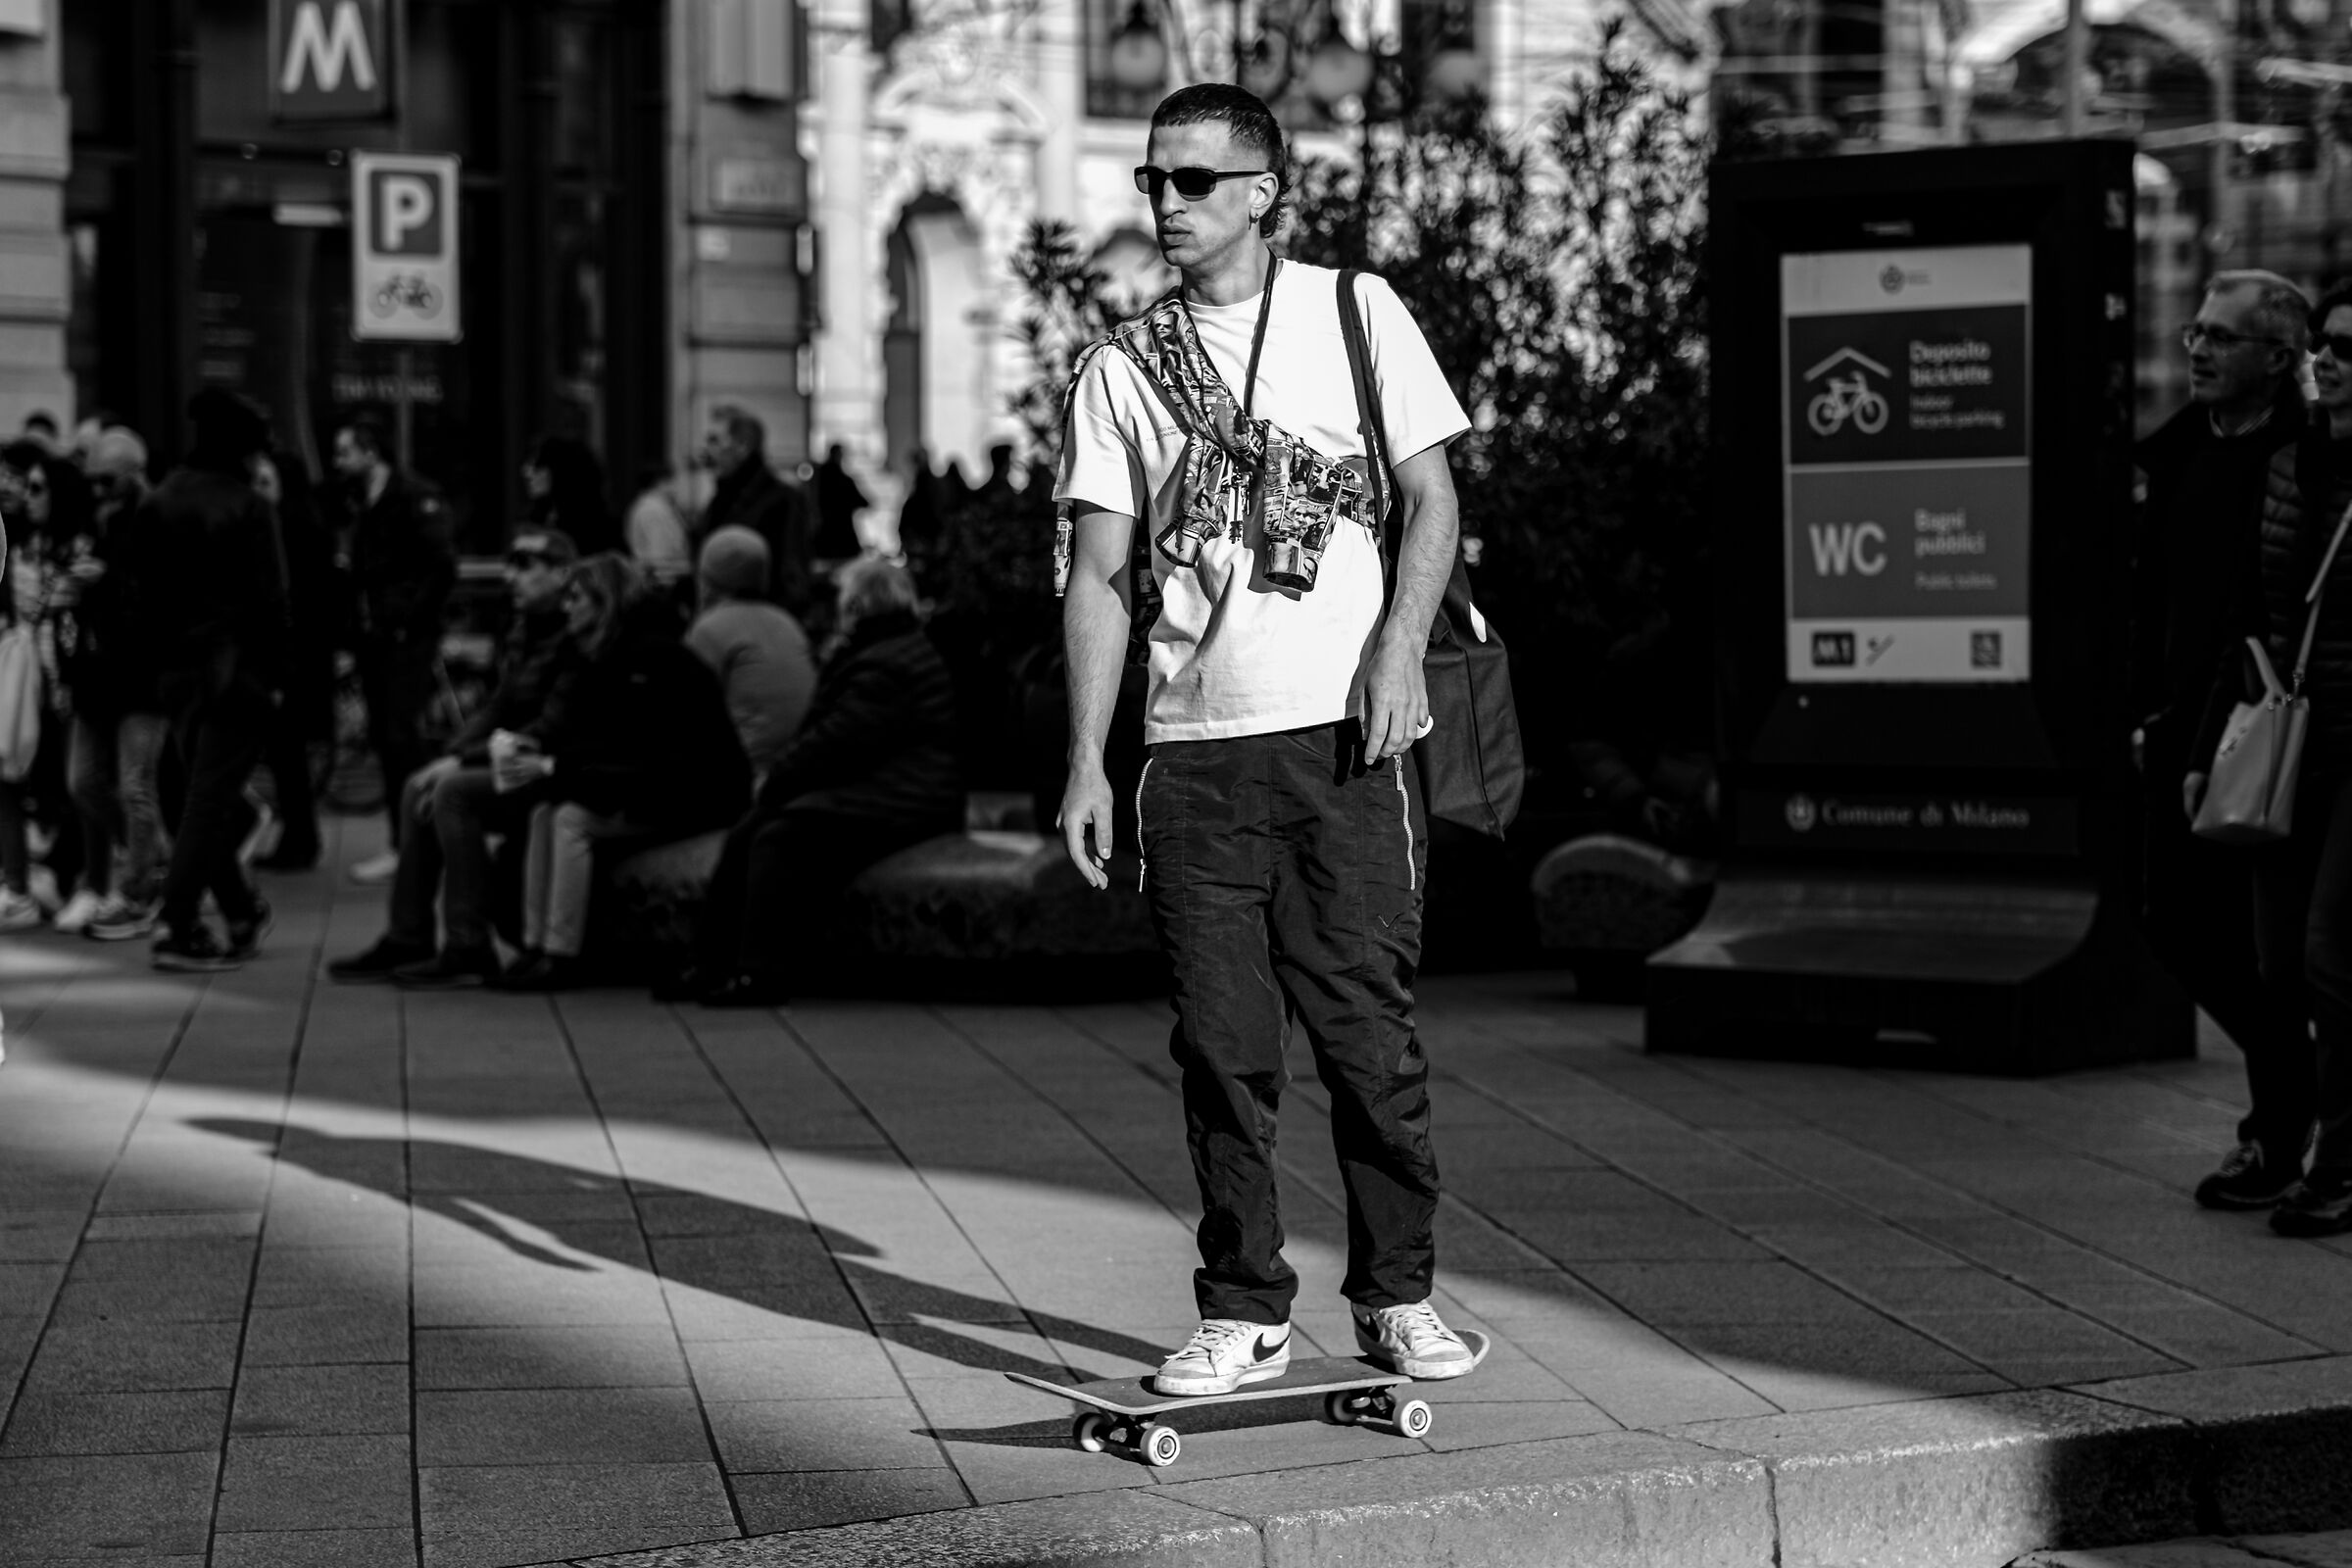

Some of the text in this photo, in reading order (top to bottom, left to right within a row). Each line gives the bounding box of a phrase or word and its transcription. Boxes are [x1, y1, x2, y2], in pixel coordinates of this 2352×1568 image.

[281, 1, 376, 92] M
[378, 175, 434, 251] P
[1910, 339, 1990, 366] Deposito
[1910, 365, 1992, 386] biciclette
[1915, 508, 1966, 535] Bagni
[1809, 521, 1886, 576] WC
[1915, 530, 1985, 558] pubblici
[1822, 798, 2030, 828] Comune di Milano
